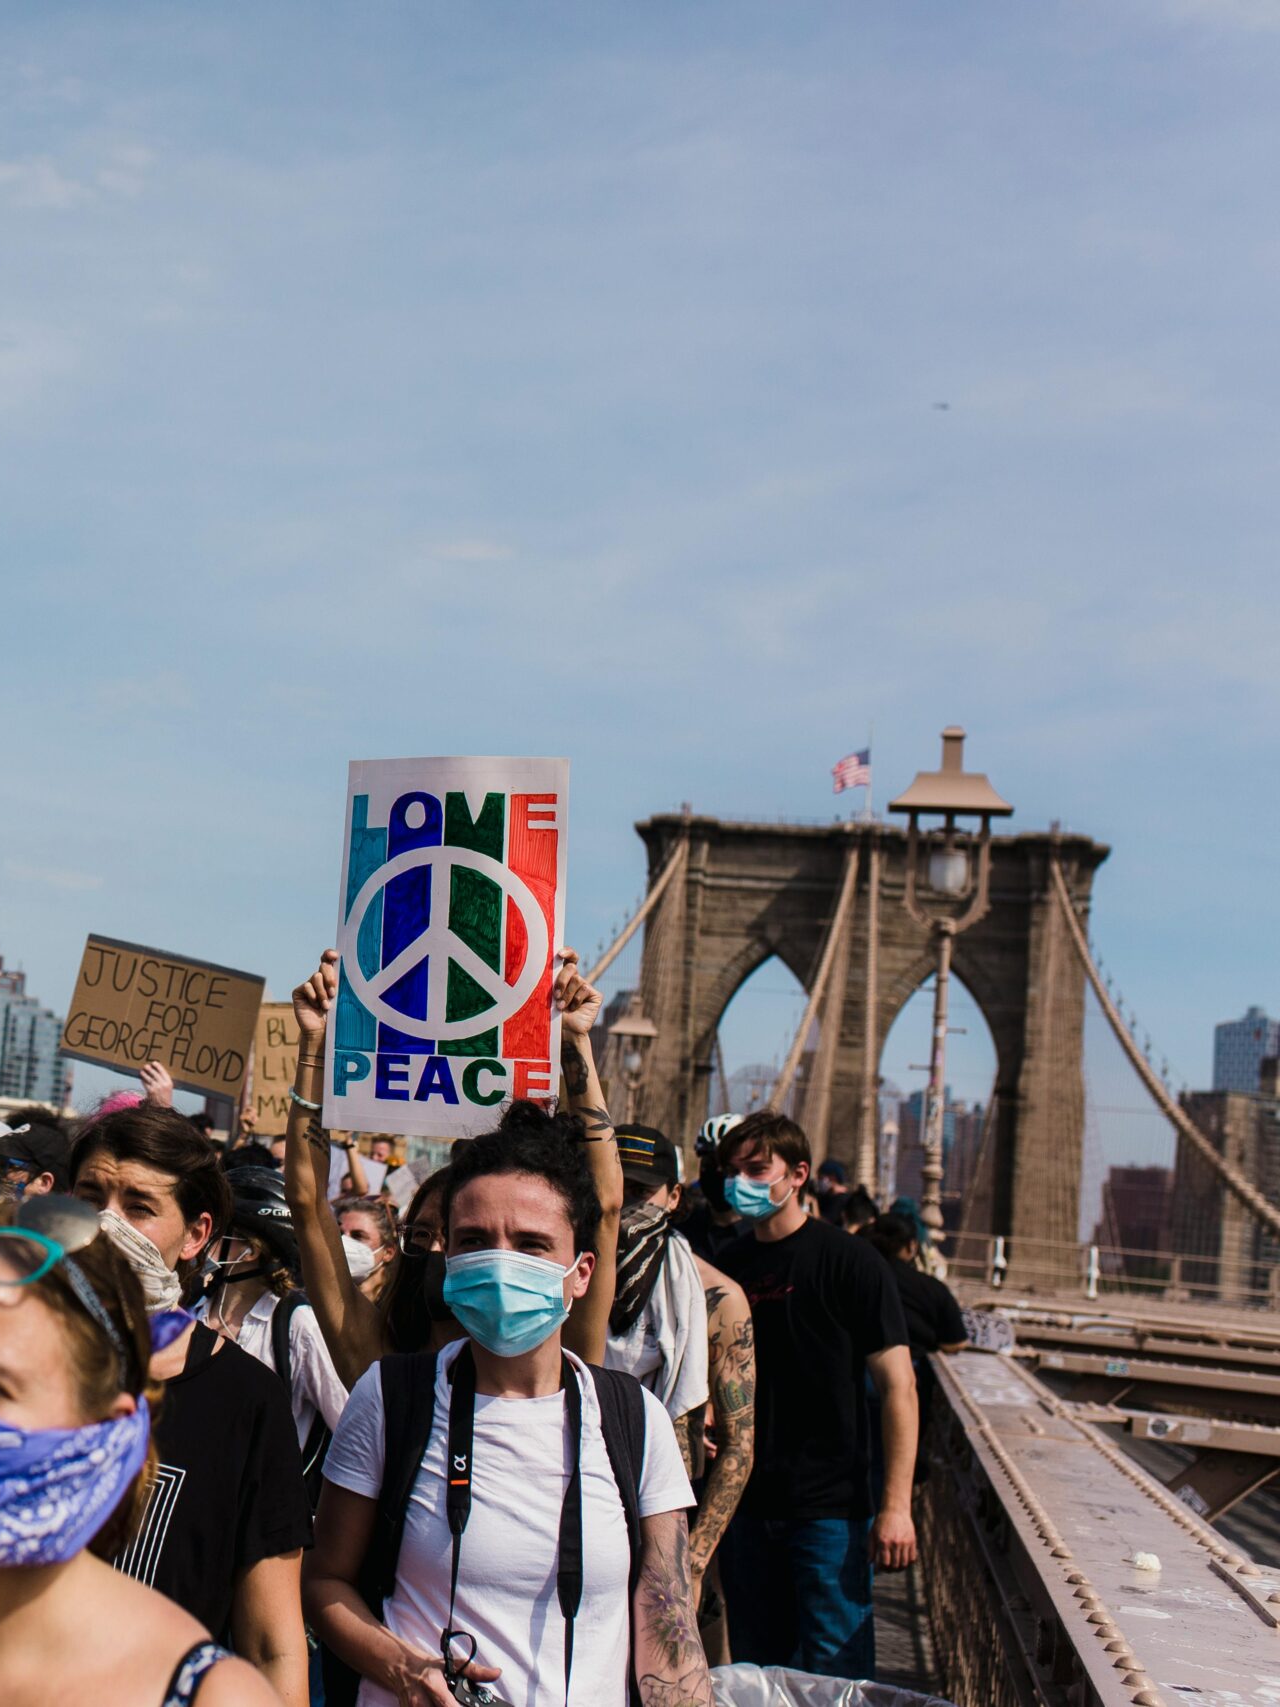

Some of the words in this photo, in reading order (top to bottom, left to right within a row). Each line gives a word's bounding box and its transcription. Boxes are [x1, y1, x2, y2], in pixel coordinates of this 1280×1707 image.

[83, 946, 230, 1009] JUSTICE
[64, 1012, 166, 1063] GEORGE
[169, 1037, 245, 1083] FLOYD
[144, 1001, 199, 1040] FOR
[333, 1050, 552, 1110] PEACE
